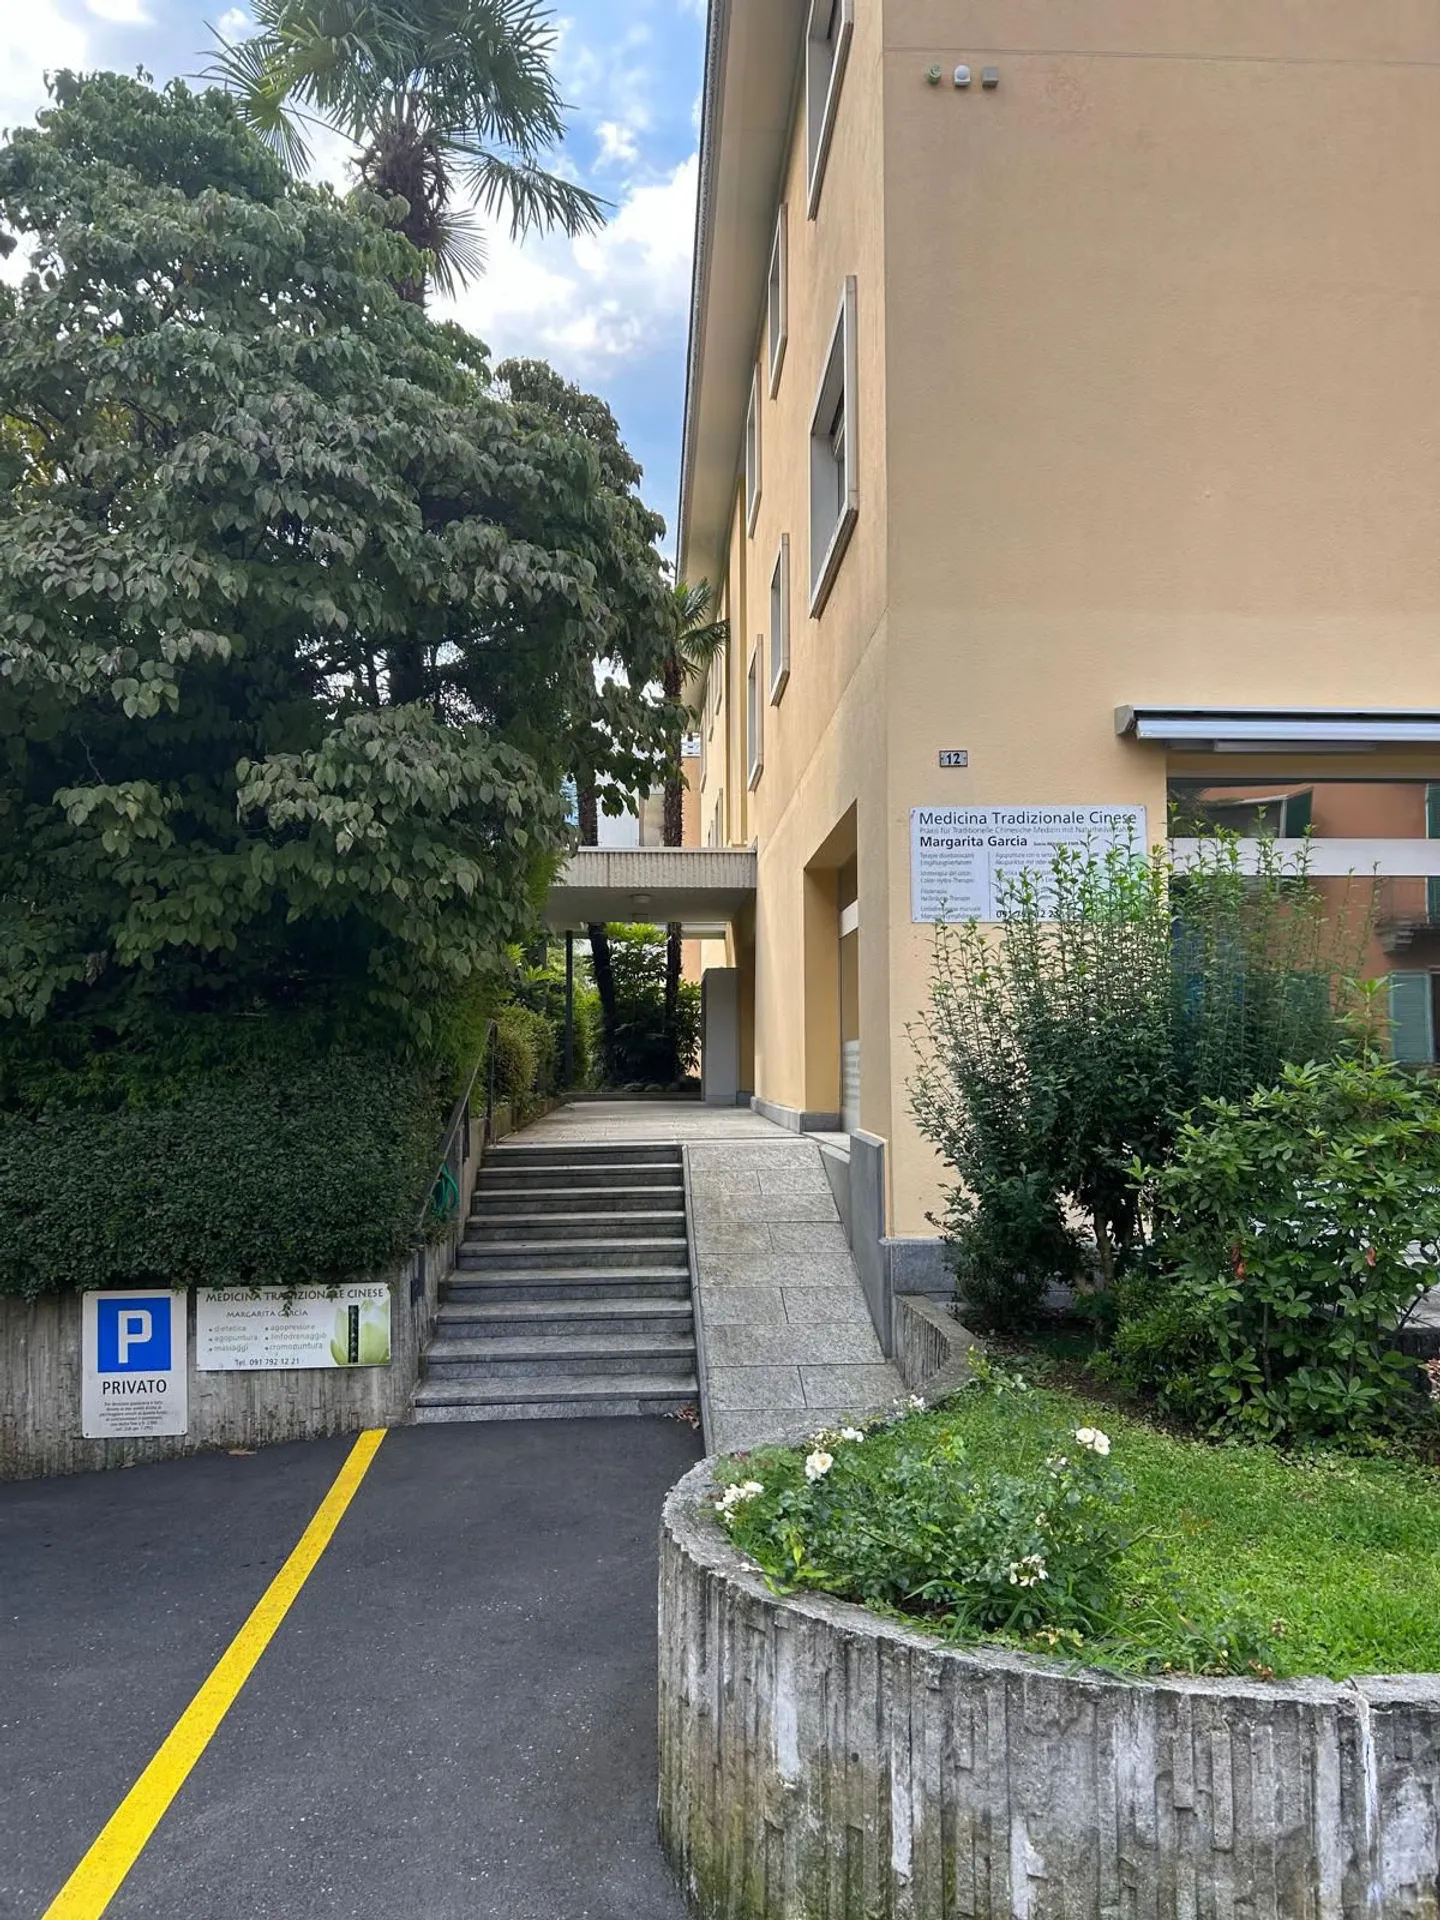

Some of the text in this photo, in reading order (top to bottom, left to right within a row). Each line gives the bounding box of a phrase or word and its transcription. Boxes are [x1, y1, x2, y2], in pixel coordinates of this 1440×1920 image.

[947, 752, 961, 765] 12
[919, 811, 1137, 825] Medicina Tradizionale Cinese
[920, 836, 984, 850] Margarita
[987, 835, 1028, 847] Garcia
[205, 1291, 262, 1302] MEDICINA
[347, 1287, 384, 1298] CINESE
[118, 1310, 152, 1364] P
[102, 1379, 167, 1395] PRIVATO
